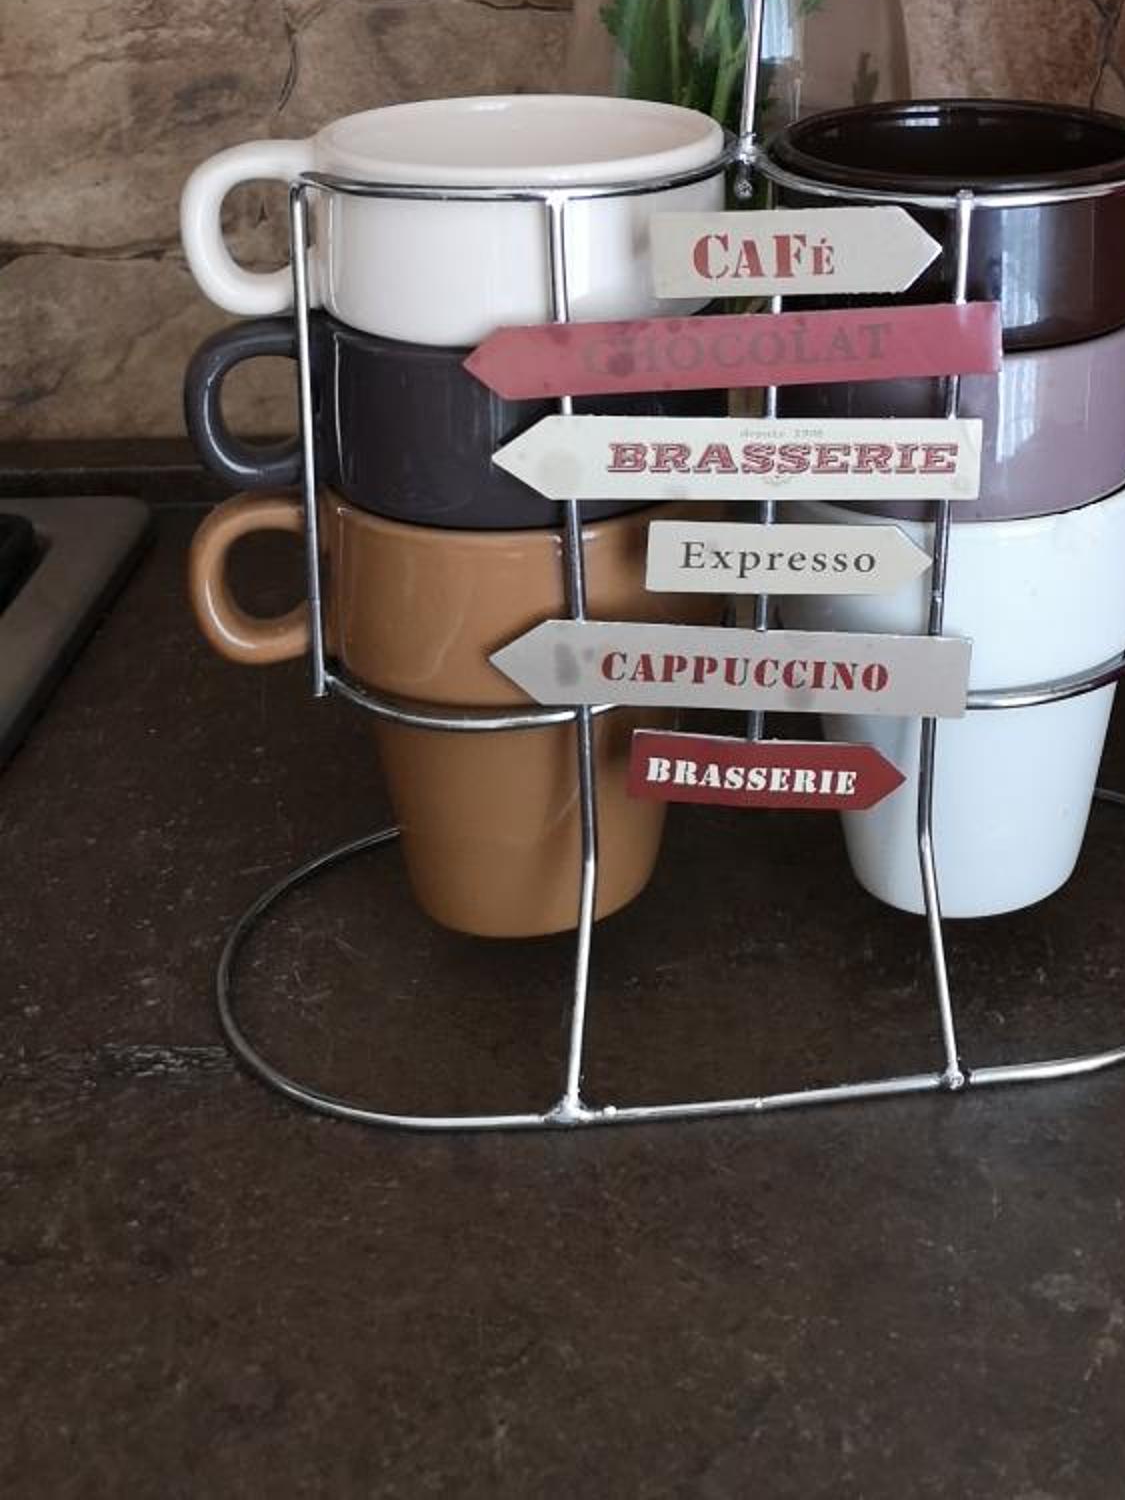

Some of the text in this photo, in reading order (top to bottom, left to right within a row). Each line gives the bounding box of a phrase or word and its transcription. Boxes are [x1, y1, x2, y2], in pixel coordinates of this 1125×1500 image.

[606, 443, 959, 475] BRASSERIE
[680, 541, 877, 579] Expresso
[601, 651, 889, 693] CAPPUCCINO
[646, 756, 857, 796] BRASSERIE
